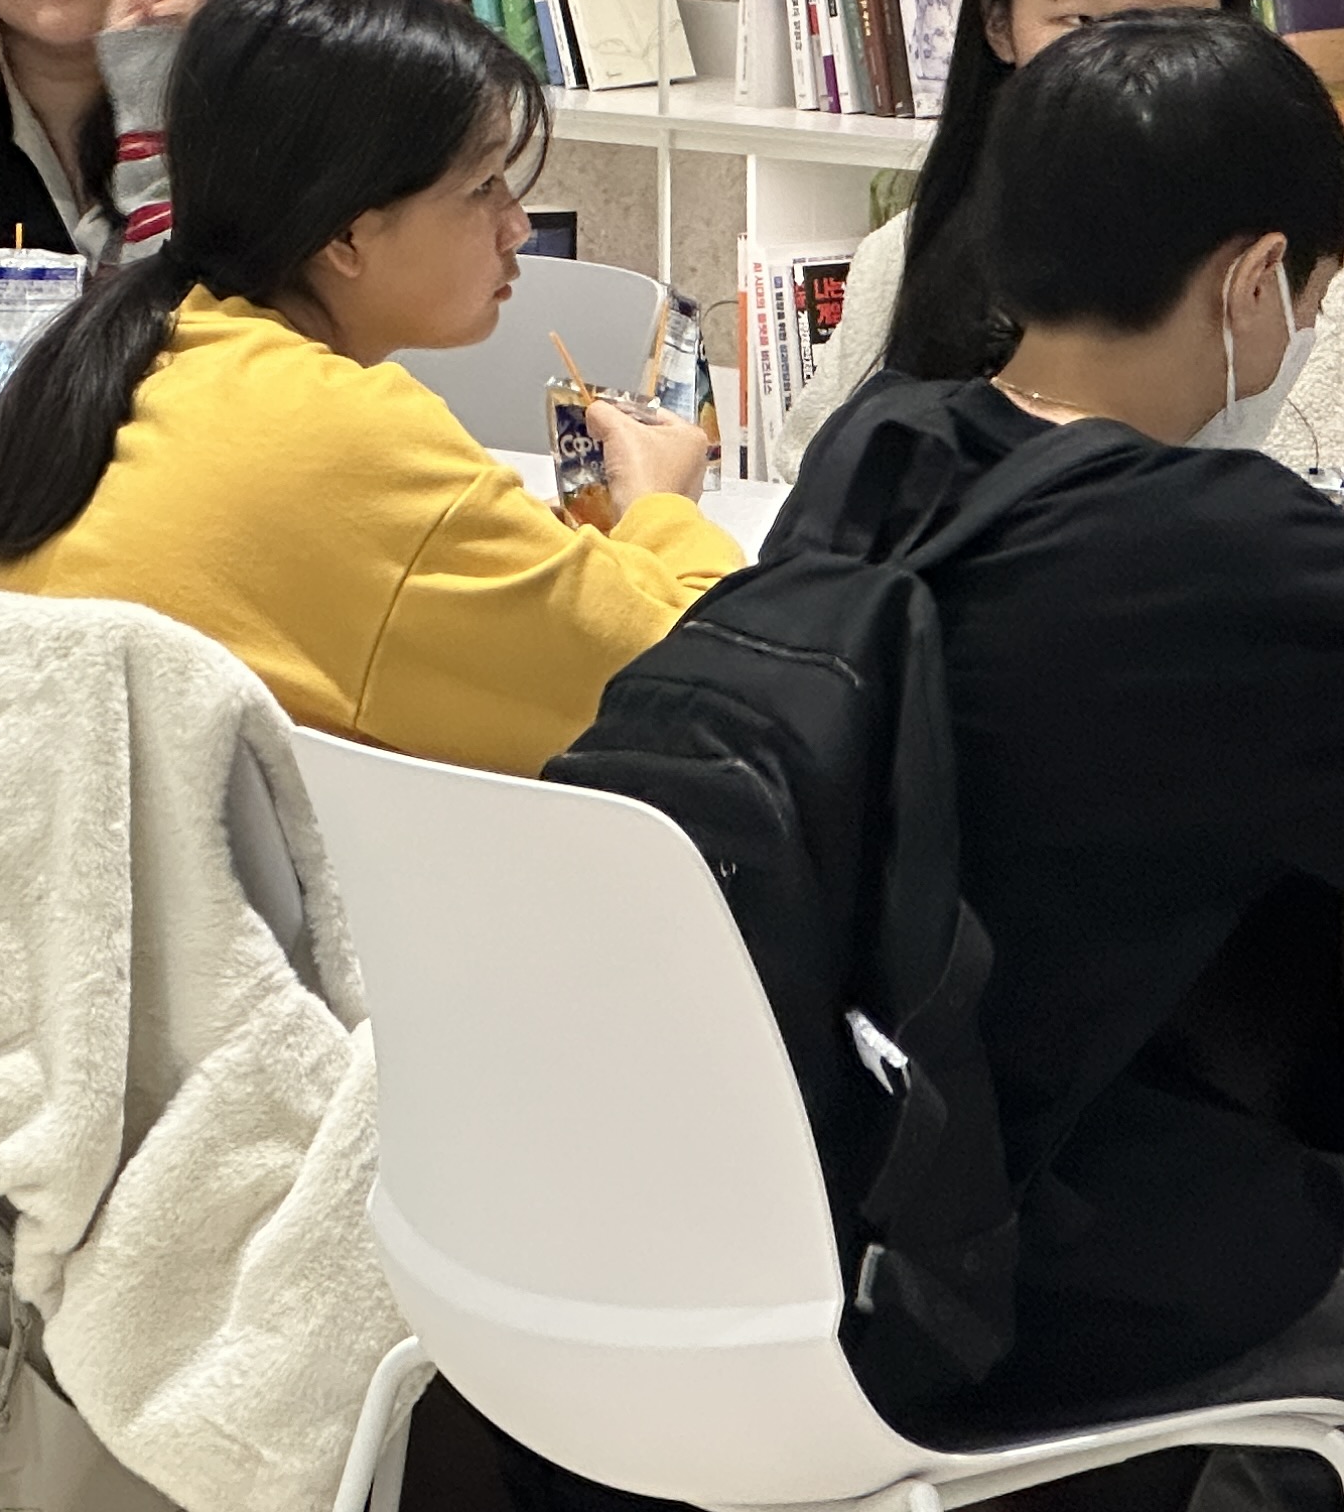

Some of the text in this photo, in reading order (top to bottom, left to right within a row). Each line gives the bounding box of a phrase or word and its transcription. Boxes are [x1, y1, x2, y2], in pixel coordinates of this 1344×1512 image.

[753, 262, 774, 395] AI 시대의 플랫폼 비즈니스
